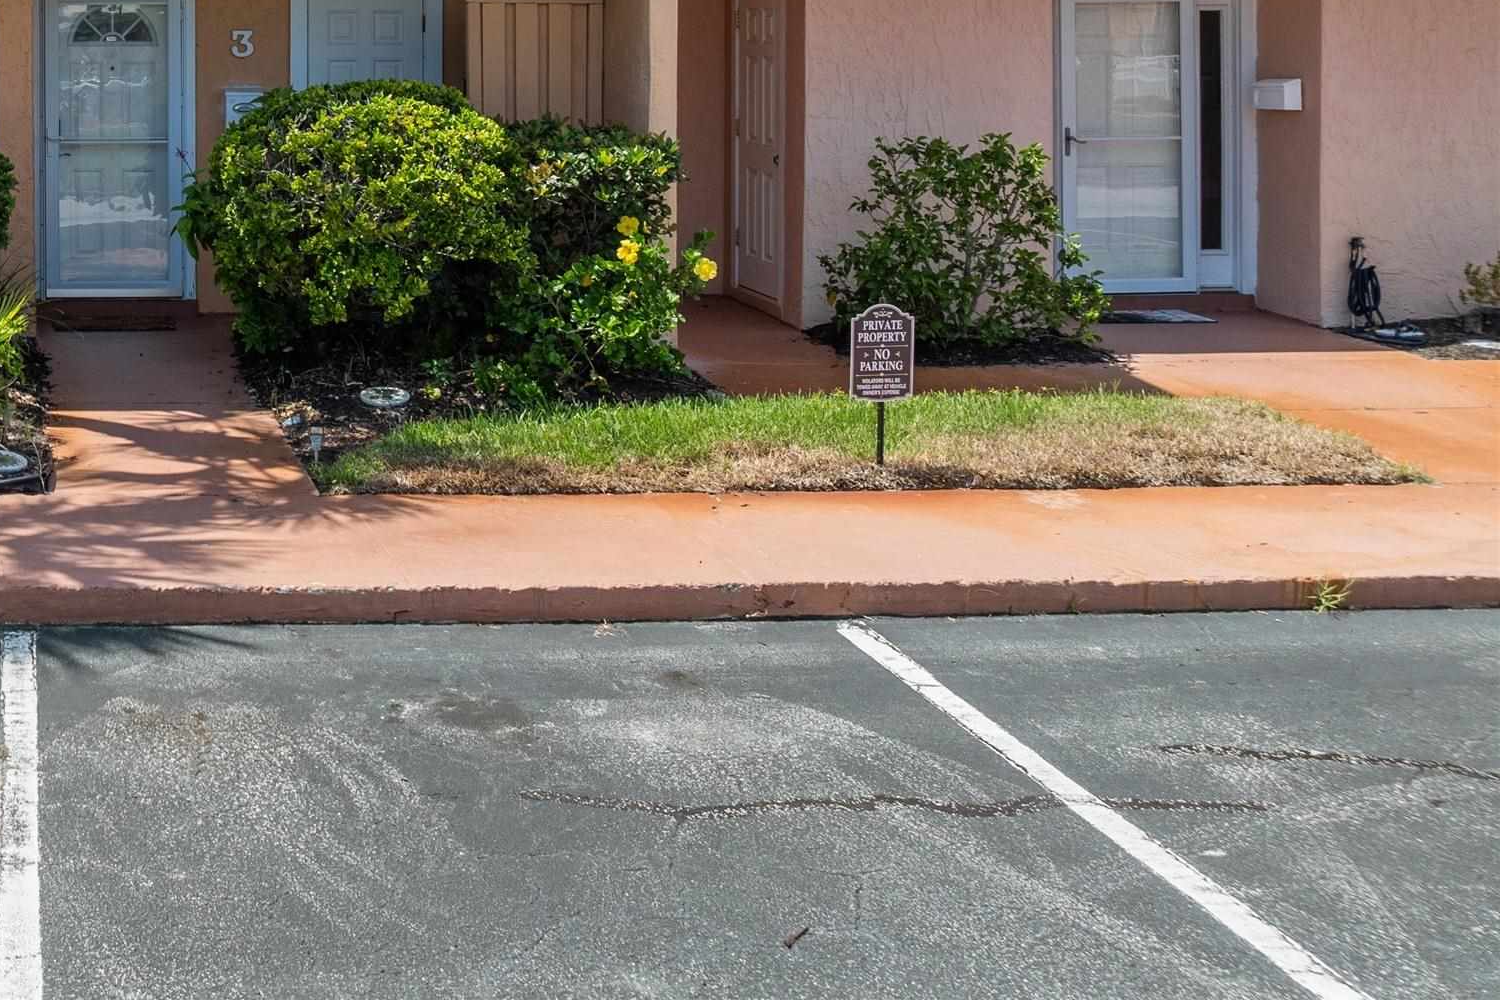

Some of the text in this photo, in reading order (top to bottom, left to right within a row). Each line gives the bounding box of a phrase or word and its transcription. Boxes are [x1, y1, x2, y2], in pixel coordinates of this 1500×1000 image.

[229, 29, 254, 58] 3
[862, 320, 903, 330] PRIVATE
[857, 332, 907, 342] PROPERTY
[874, 348, 890, 360] NO
[860, 360, 903, 371] PARKING
